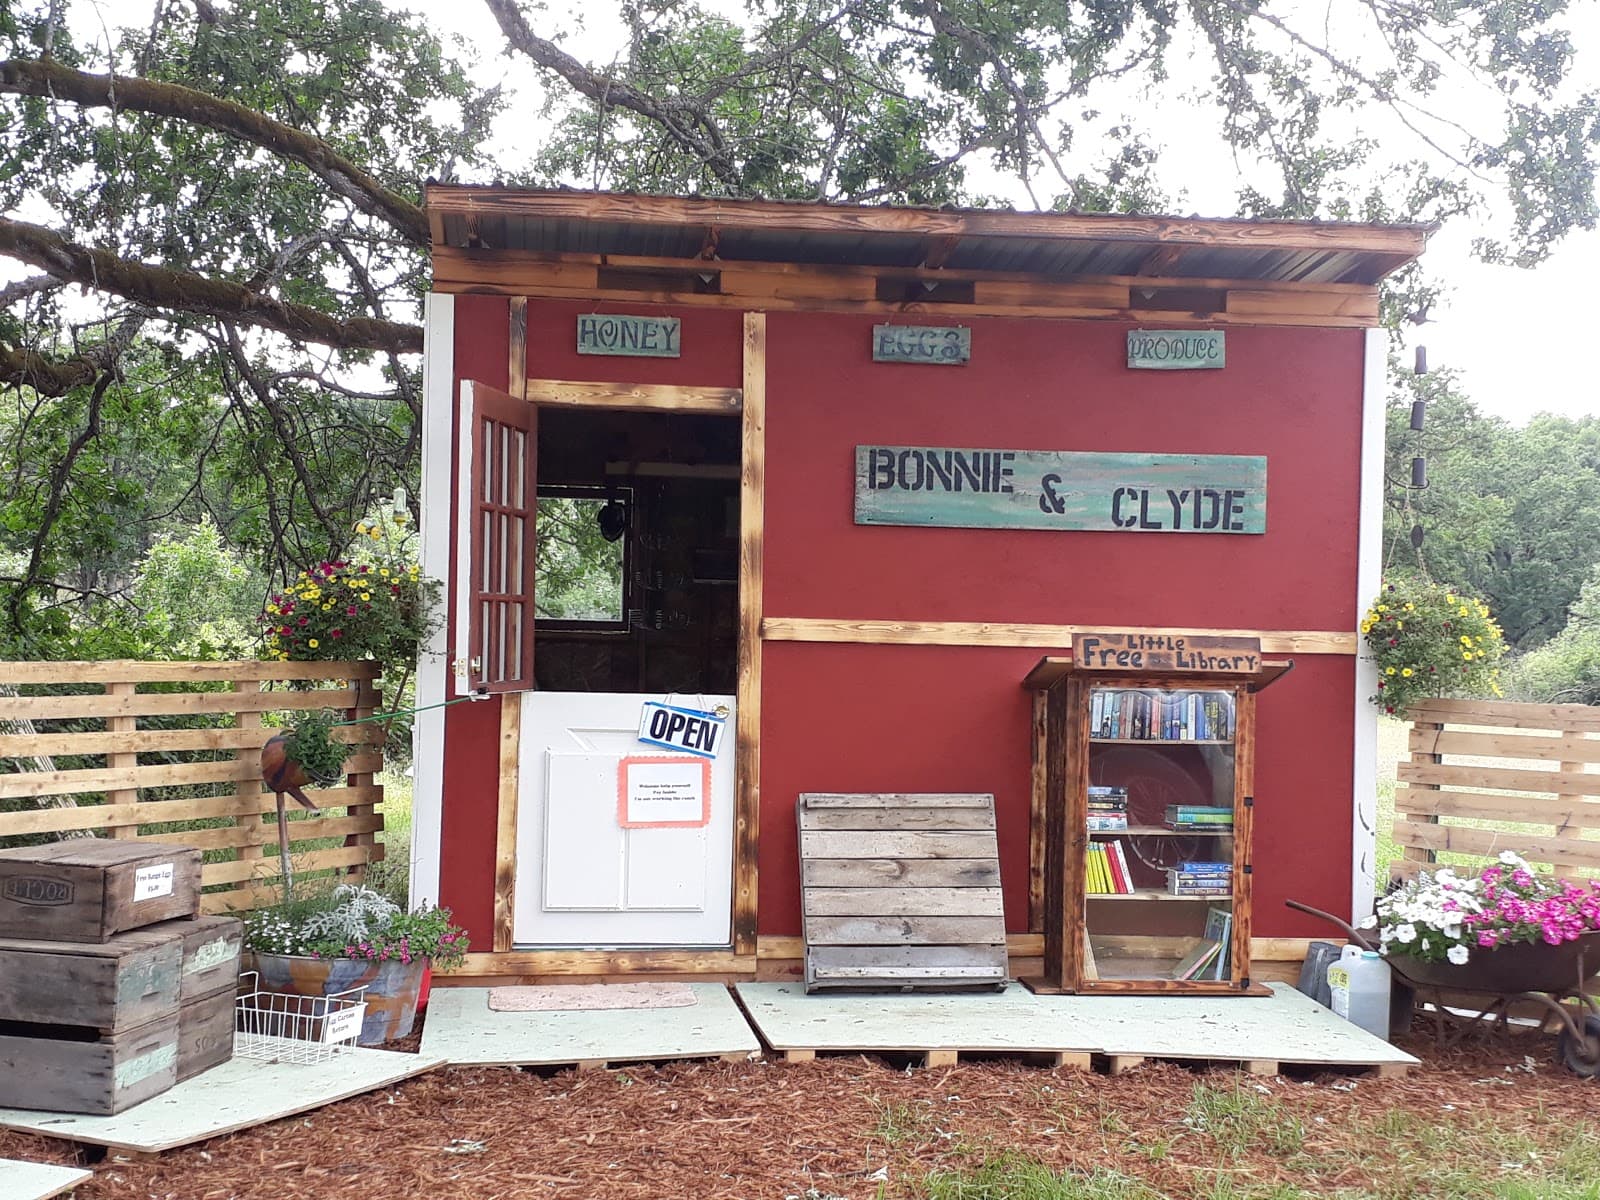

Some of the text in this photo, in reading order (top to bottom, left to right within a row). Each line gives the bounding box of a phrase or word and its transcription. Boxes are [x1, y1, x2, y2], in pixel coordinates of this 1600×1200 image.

[581, 319, 678, 351] HONEY
[879, 331, 961, 360] EGGS
[1128, 337, 1218, 360] PRODUCE
[868, 448, 1245, 531] BONNIE & CLYDE
[1083, 638, 1143, 668] Free
[649, 708, 719, 753] OPEN
